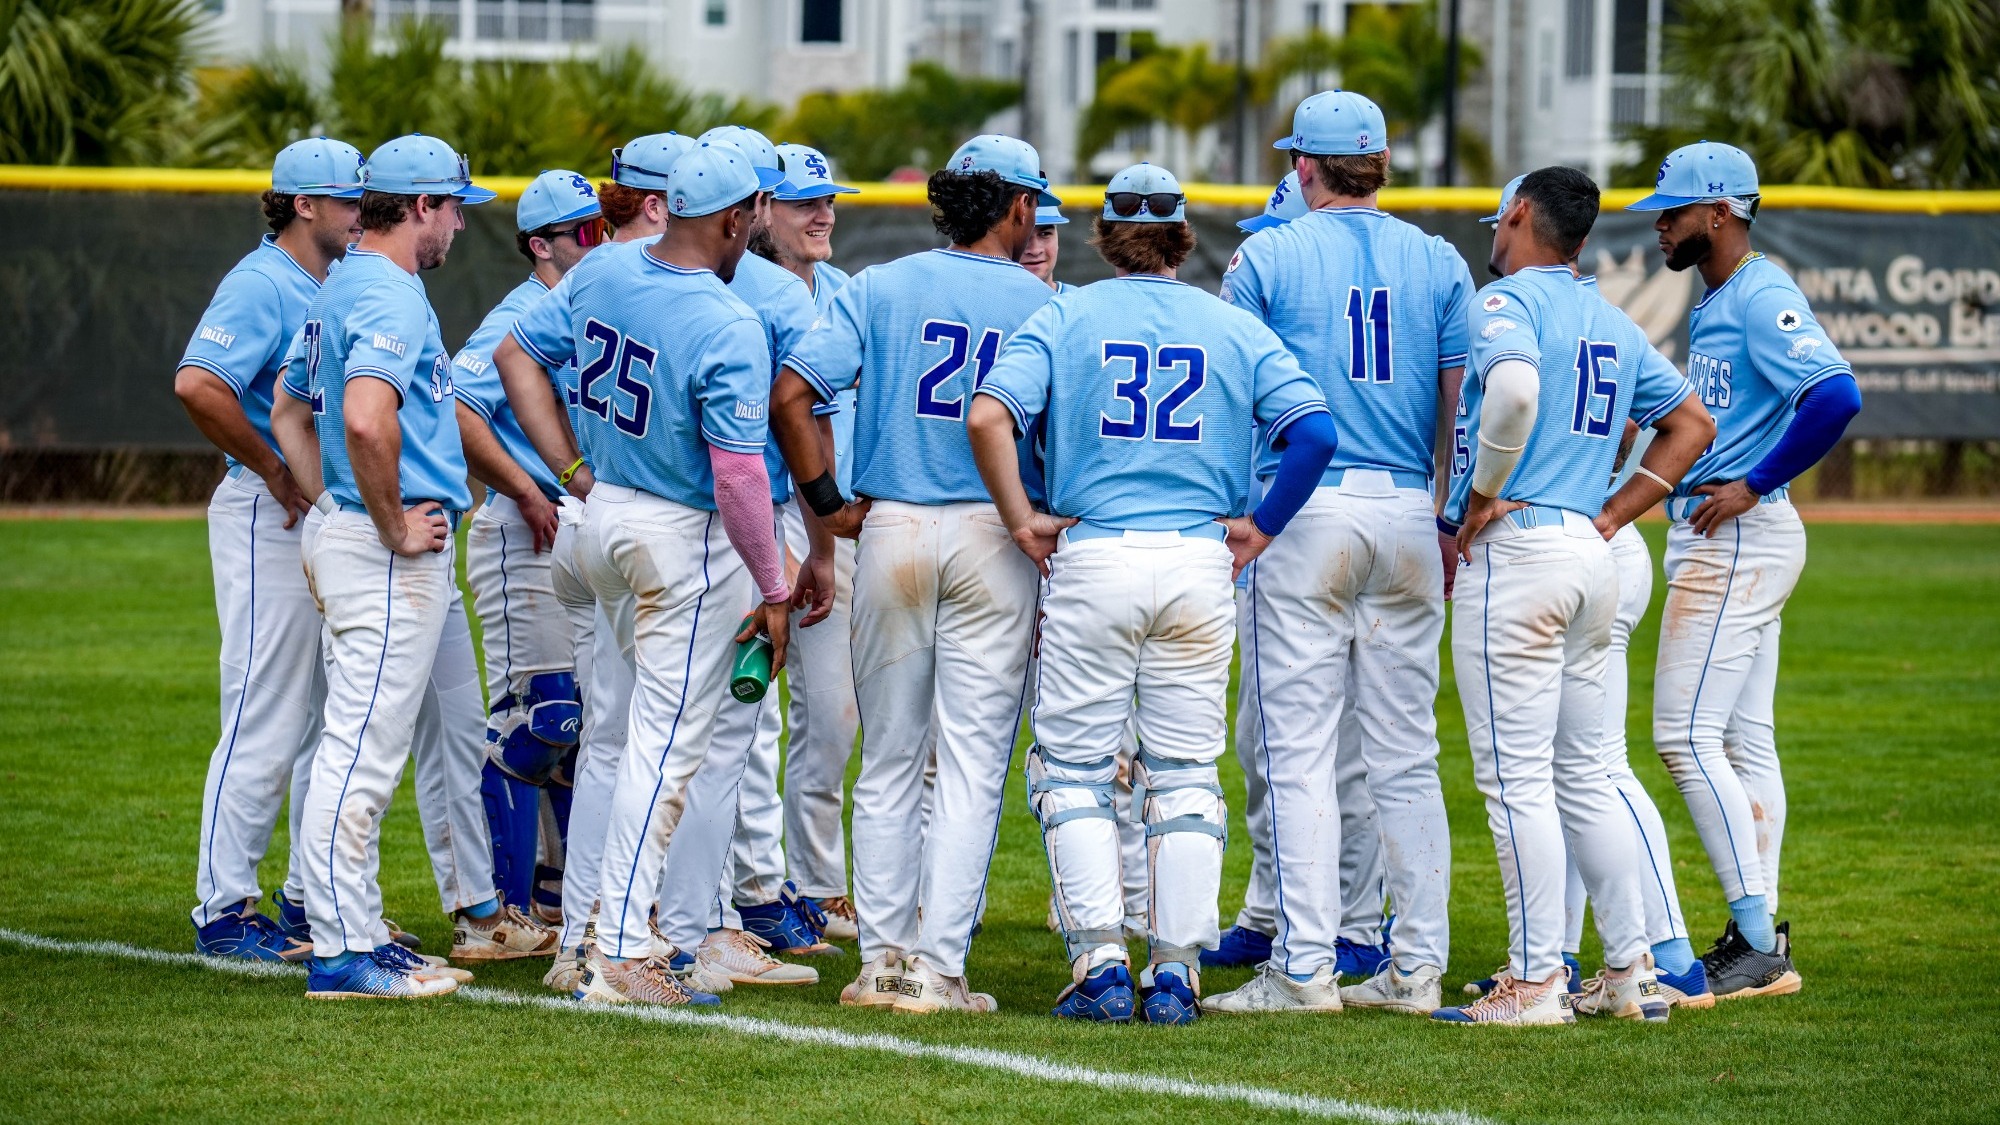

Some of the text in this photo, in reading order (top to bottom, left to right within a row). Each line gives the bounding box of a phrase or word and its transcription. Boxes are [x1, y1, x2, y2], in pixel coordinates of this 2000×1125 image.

[199, 325, 236, 350] VALLEY
[373, 332, 407, 359] VALLEY
[455, 352, 490, 378] VALLEY
[580, 317, 659, 440] 25
[916, 318, 1003, 422] 21
[1344, 286, 1393, 384] 11
[1099, 339, 1208, 443] 32
[1571, 336, 1619, 440] 15
